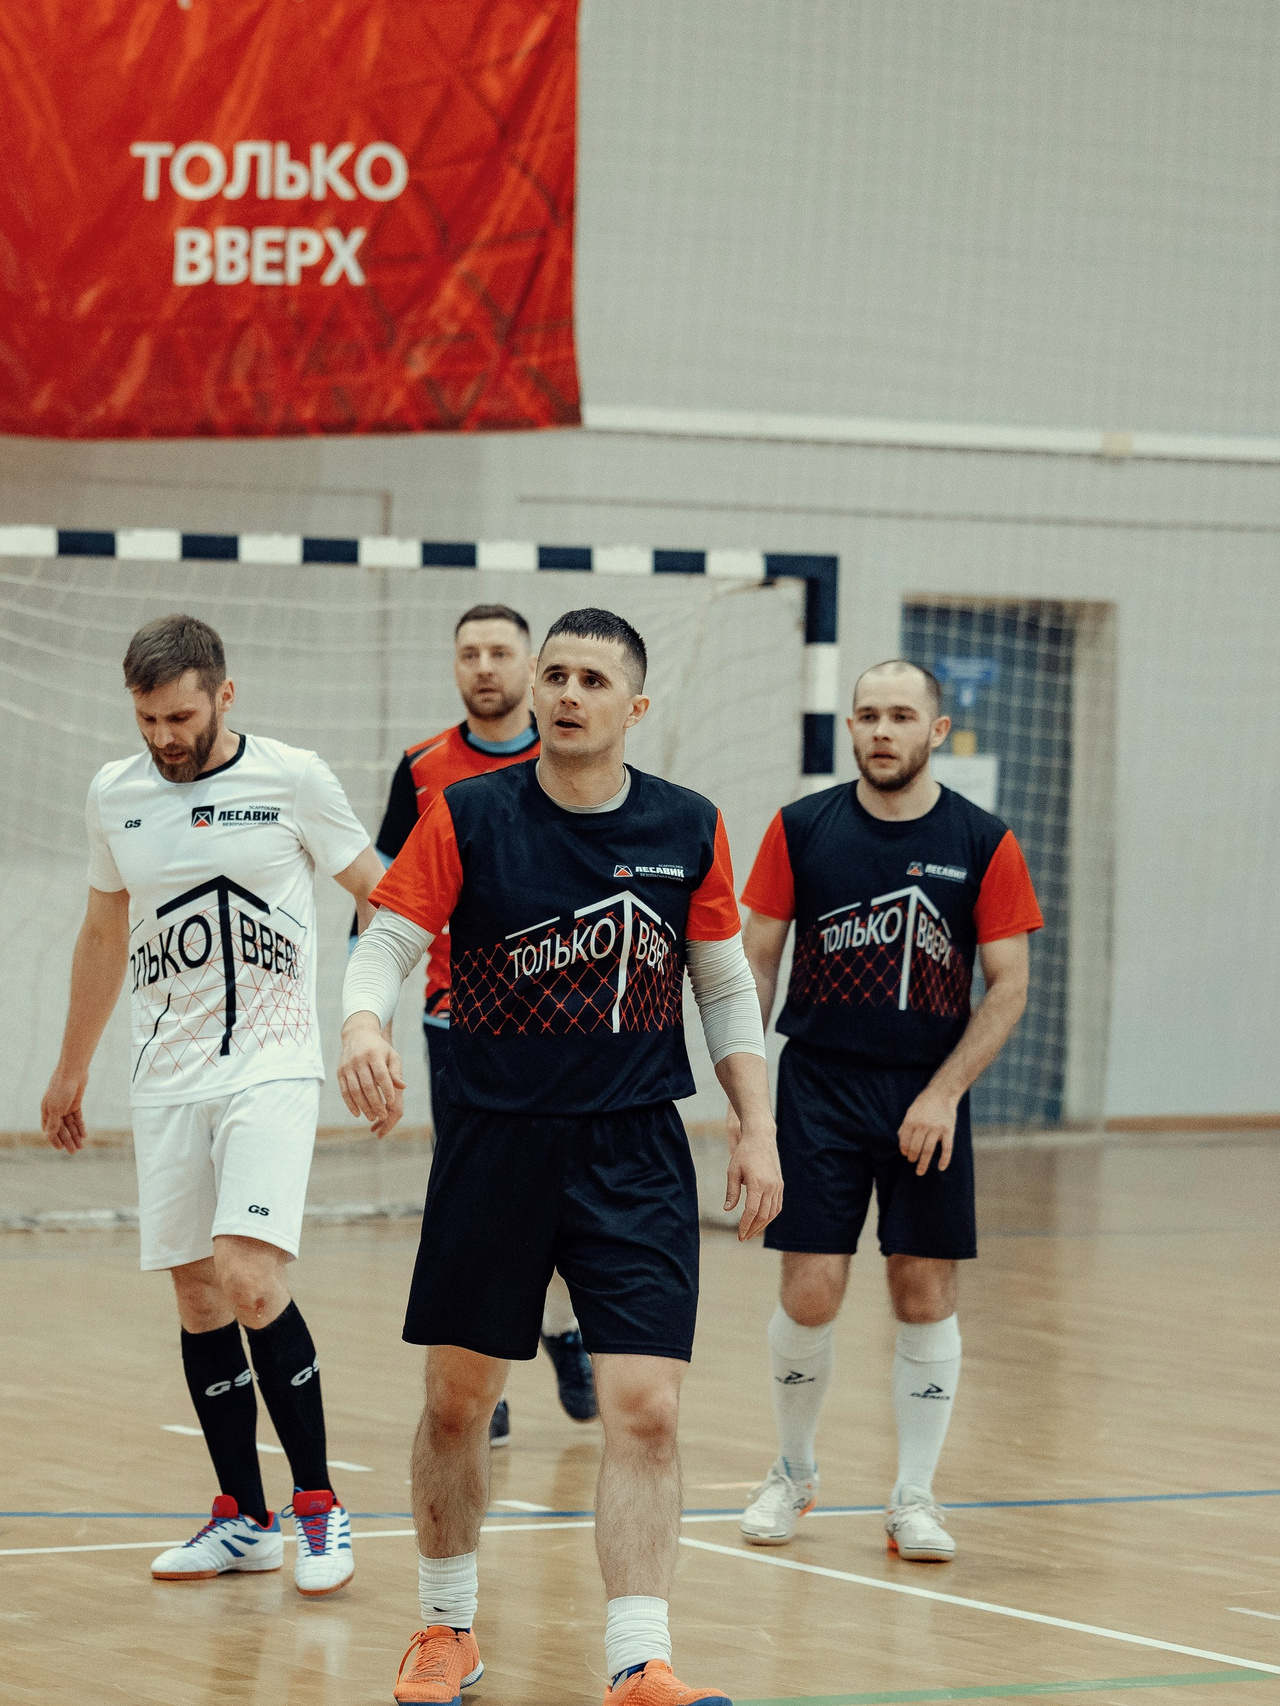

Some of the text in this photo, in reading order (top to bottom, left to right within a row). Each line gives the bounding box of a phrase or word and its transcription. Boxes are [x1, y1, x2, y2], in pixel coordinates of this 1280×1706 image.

[130, 140, 409, 201] ТОЛЬКО
[173, 226, 367, 286] ВВЕРХ
[124, 819, 142, 829] GS
[217, 810, 279, 821] ЛЕСАВИК
[509, 917, 616, 979] ТОЛЬКО
[820, 906, 903, 955] ТОЛЬКО
[247, 1204, 270, 1217] GS
[205, 1368, 254, 1397] GS
